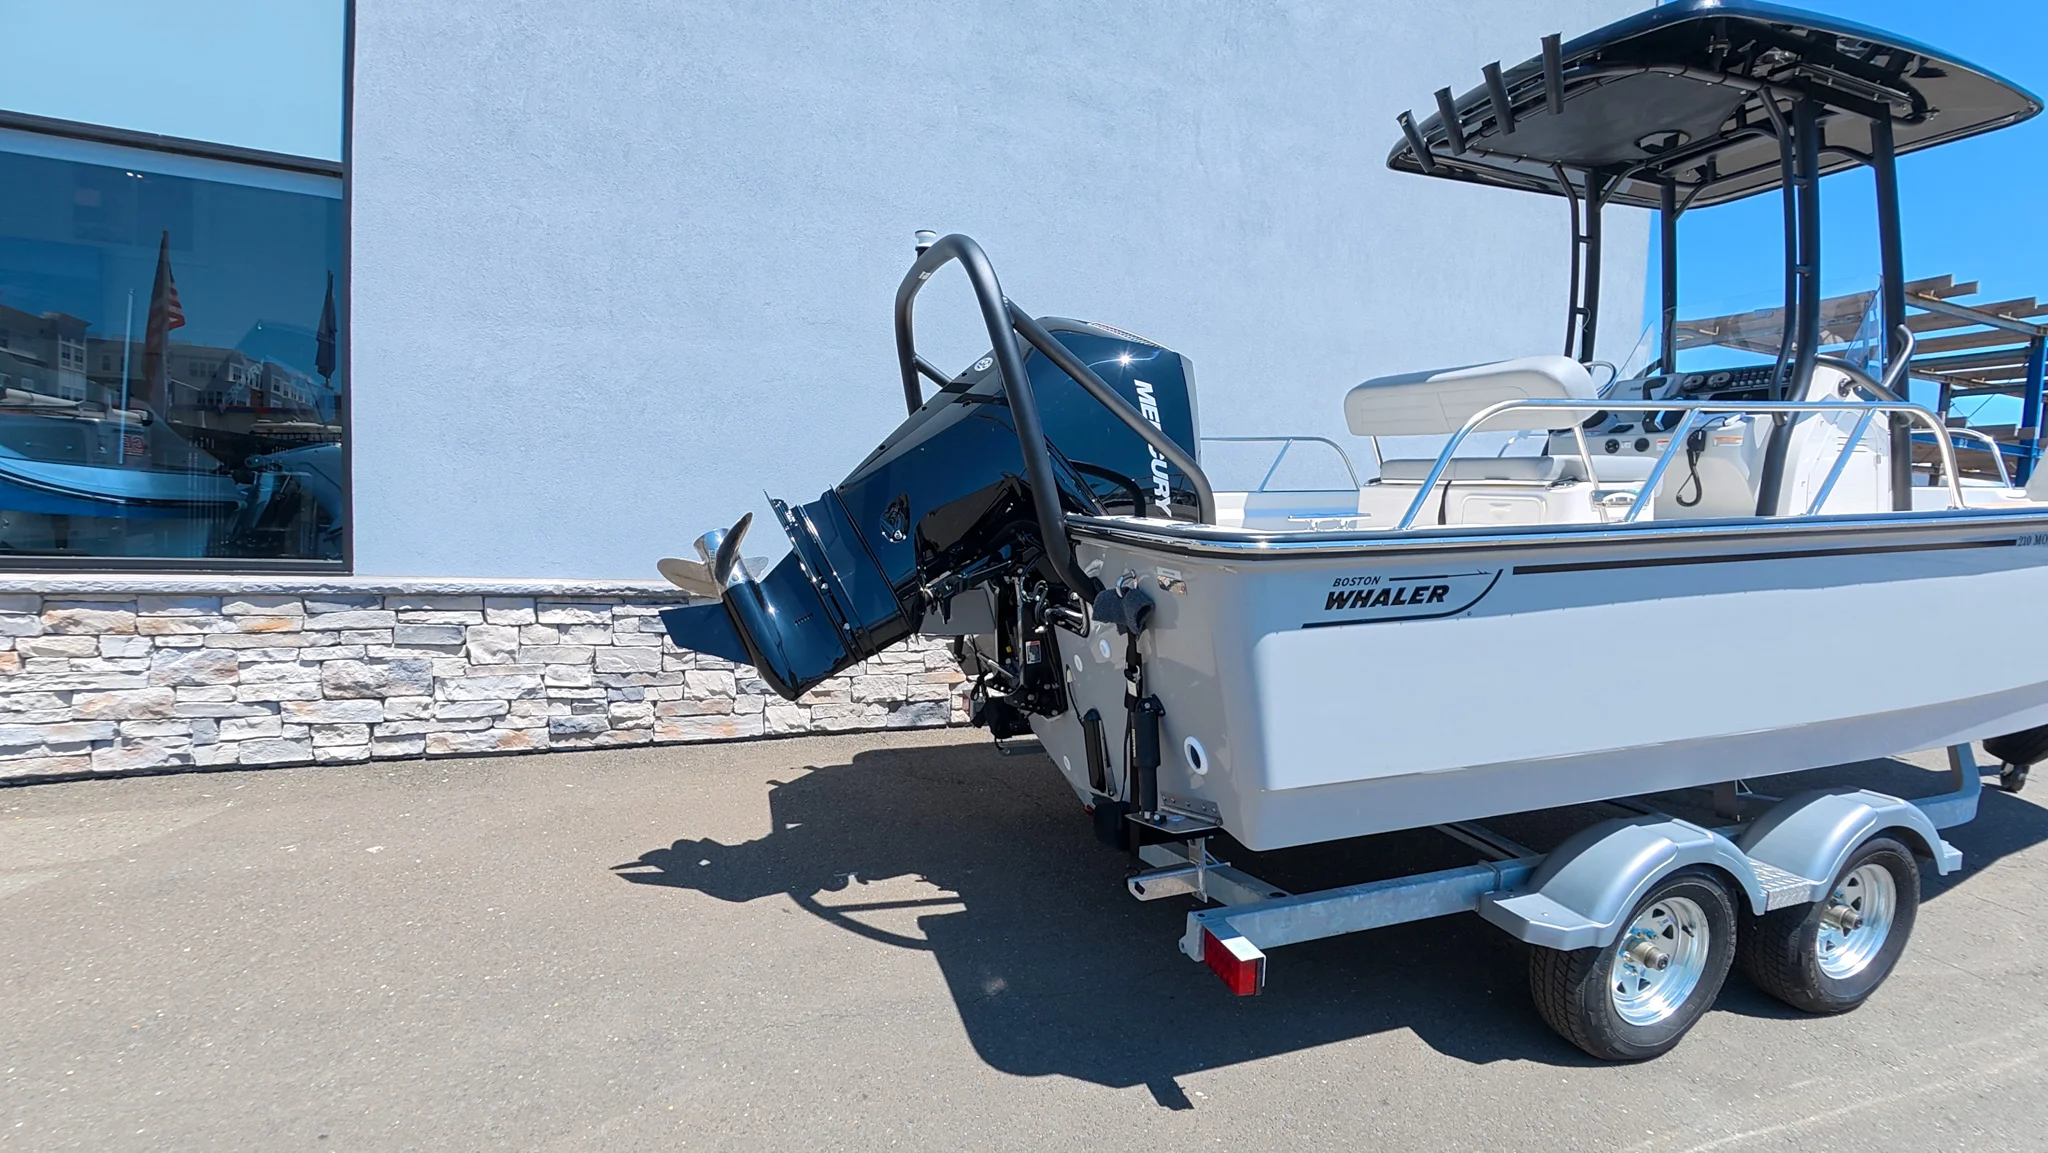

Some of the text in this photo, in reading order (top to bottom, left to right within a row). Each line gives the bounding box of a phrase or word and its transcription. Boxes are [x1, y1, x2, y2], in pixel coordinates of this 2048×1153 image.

[1133, 379, 1172, 518] MECURY
[1333, 576, 1381, 587] BOSTON
[1325, 585, 1450, 611] WHALER
